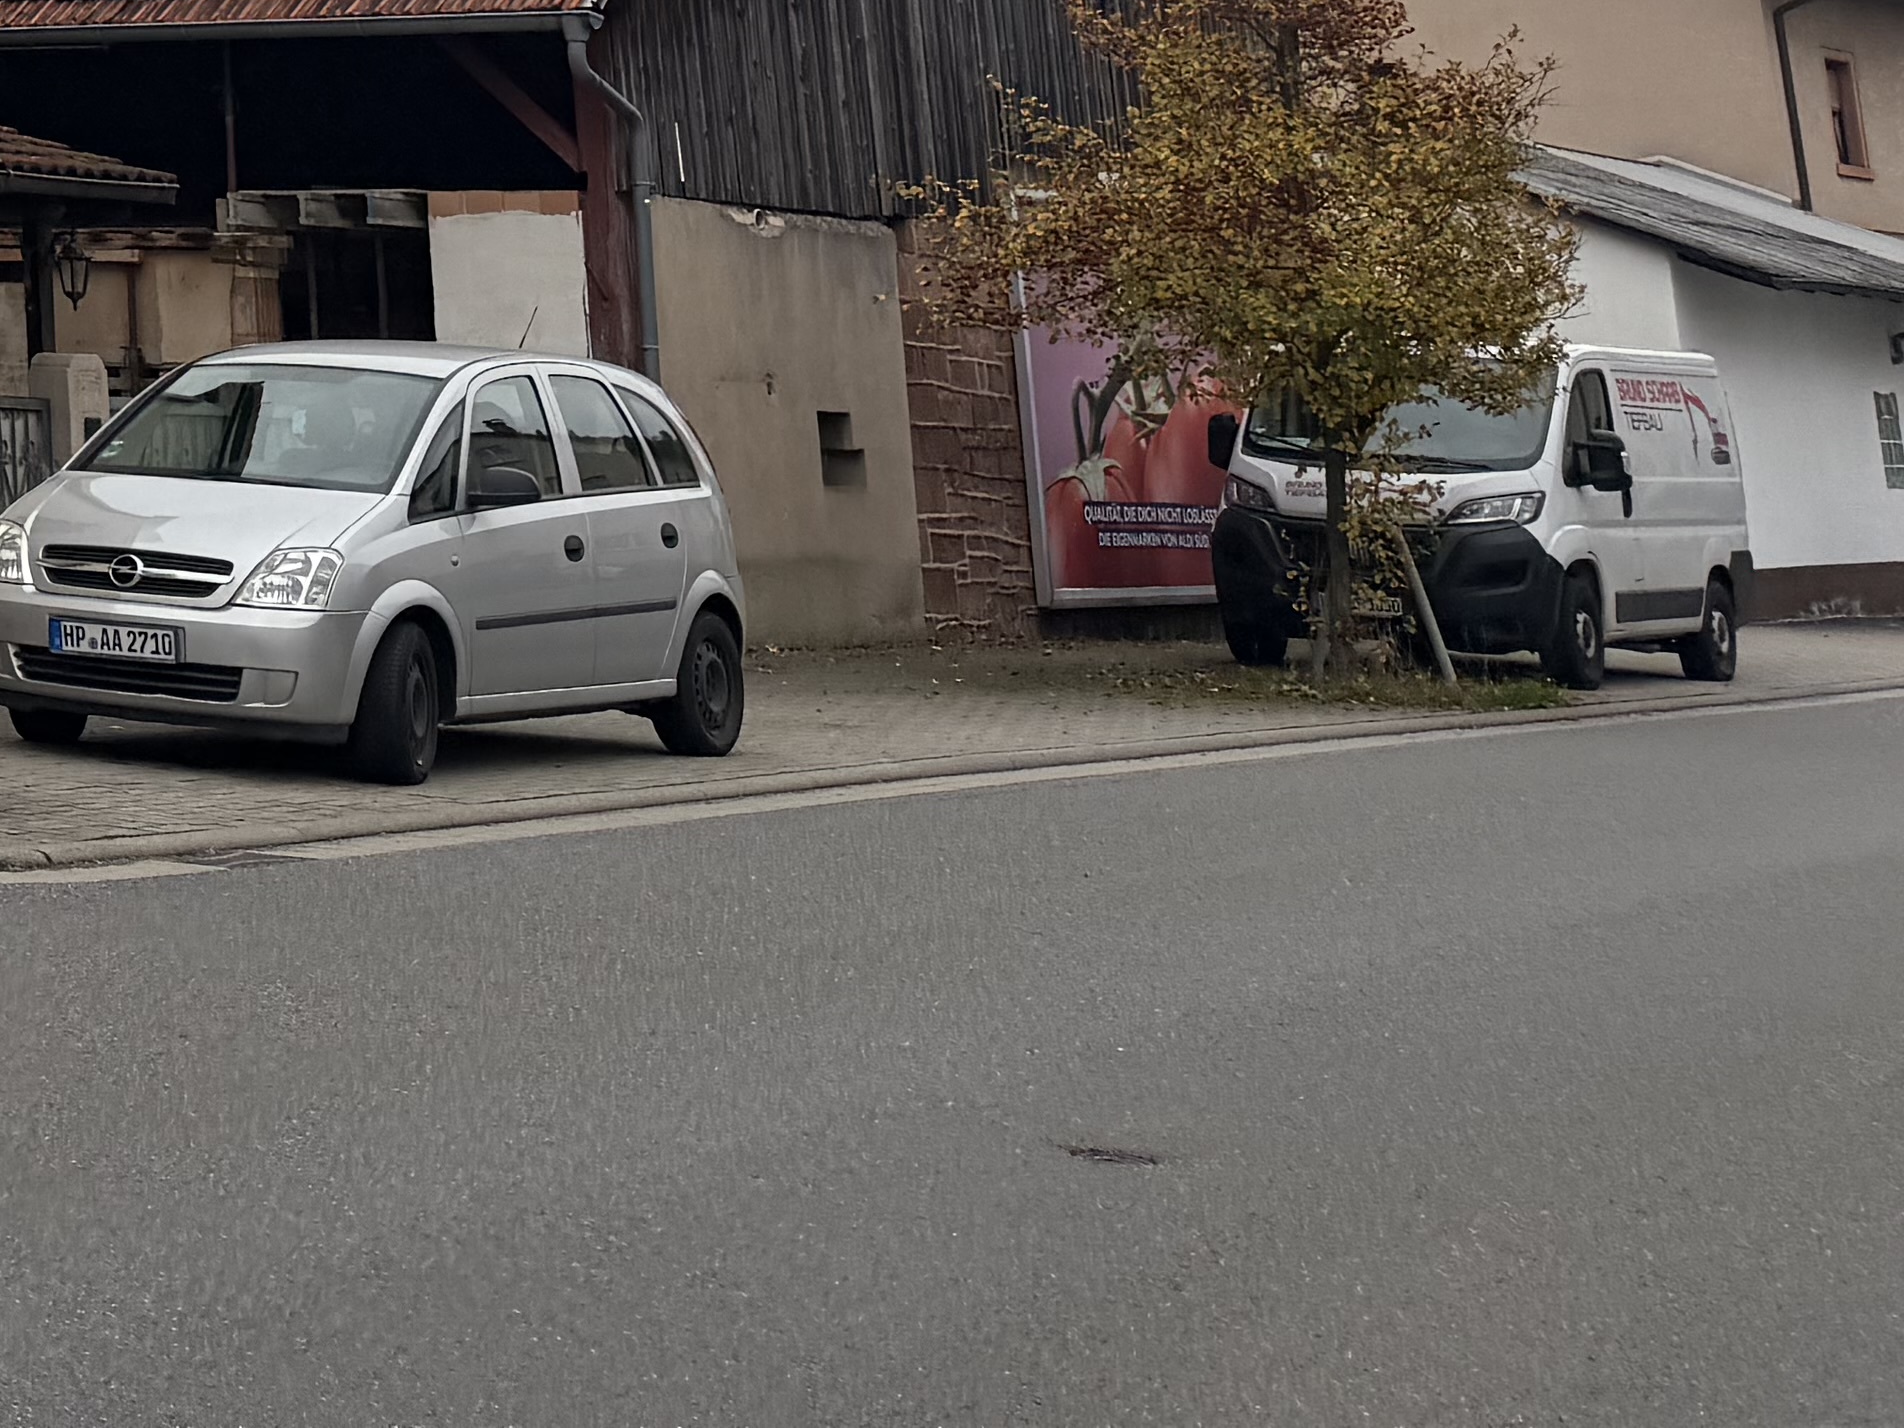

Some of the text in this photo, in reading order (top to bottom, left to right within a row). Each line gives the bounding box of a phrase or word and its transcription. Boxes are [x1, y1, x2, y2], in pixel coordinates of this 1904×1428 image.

[1124, 506, 1137, 522] DIE
[1137, 506, 1156, 522] DICH
[1157, 507, 1182, 523] NICHT
[63, 624, 172, 656] HP AA 2710
